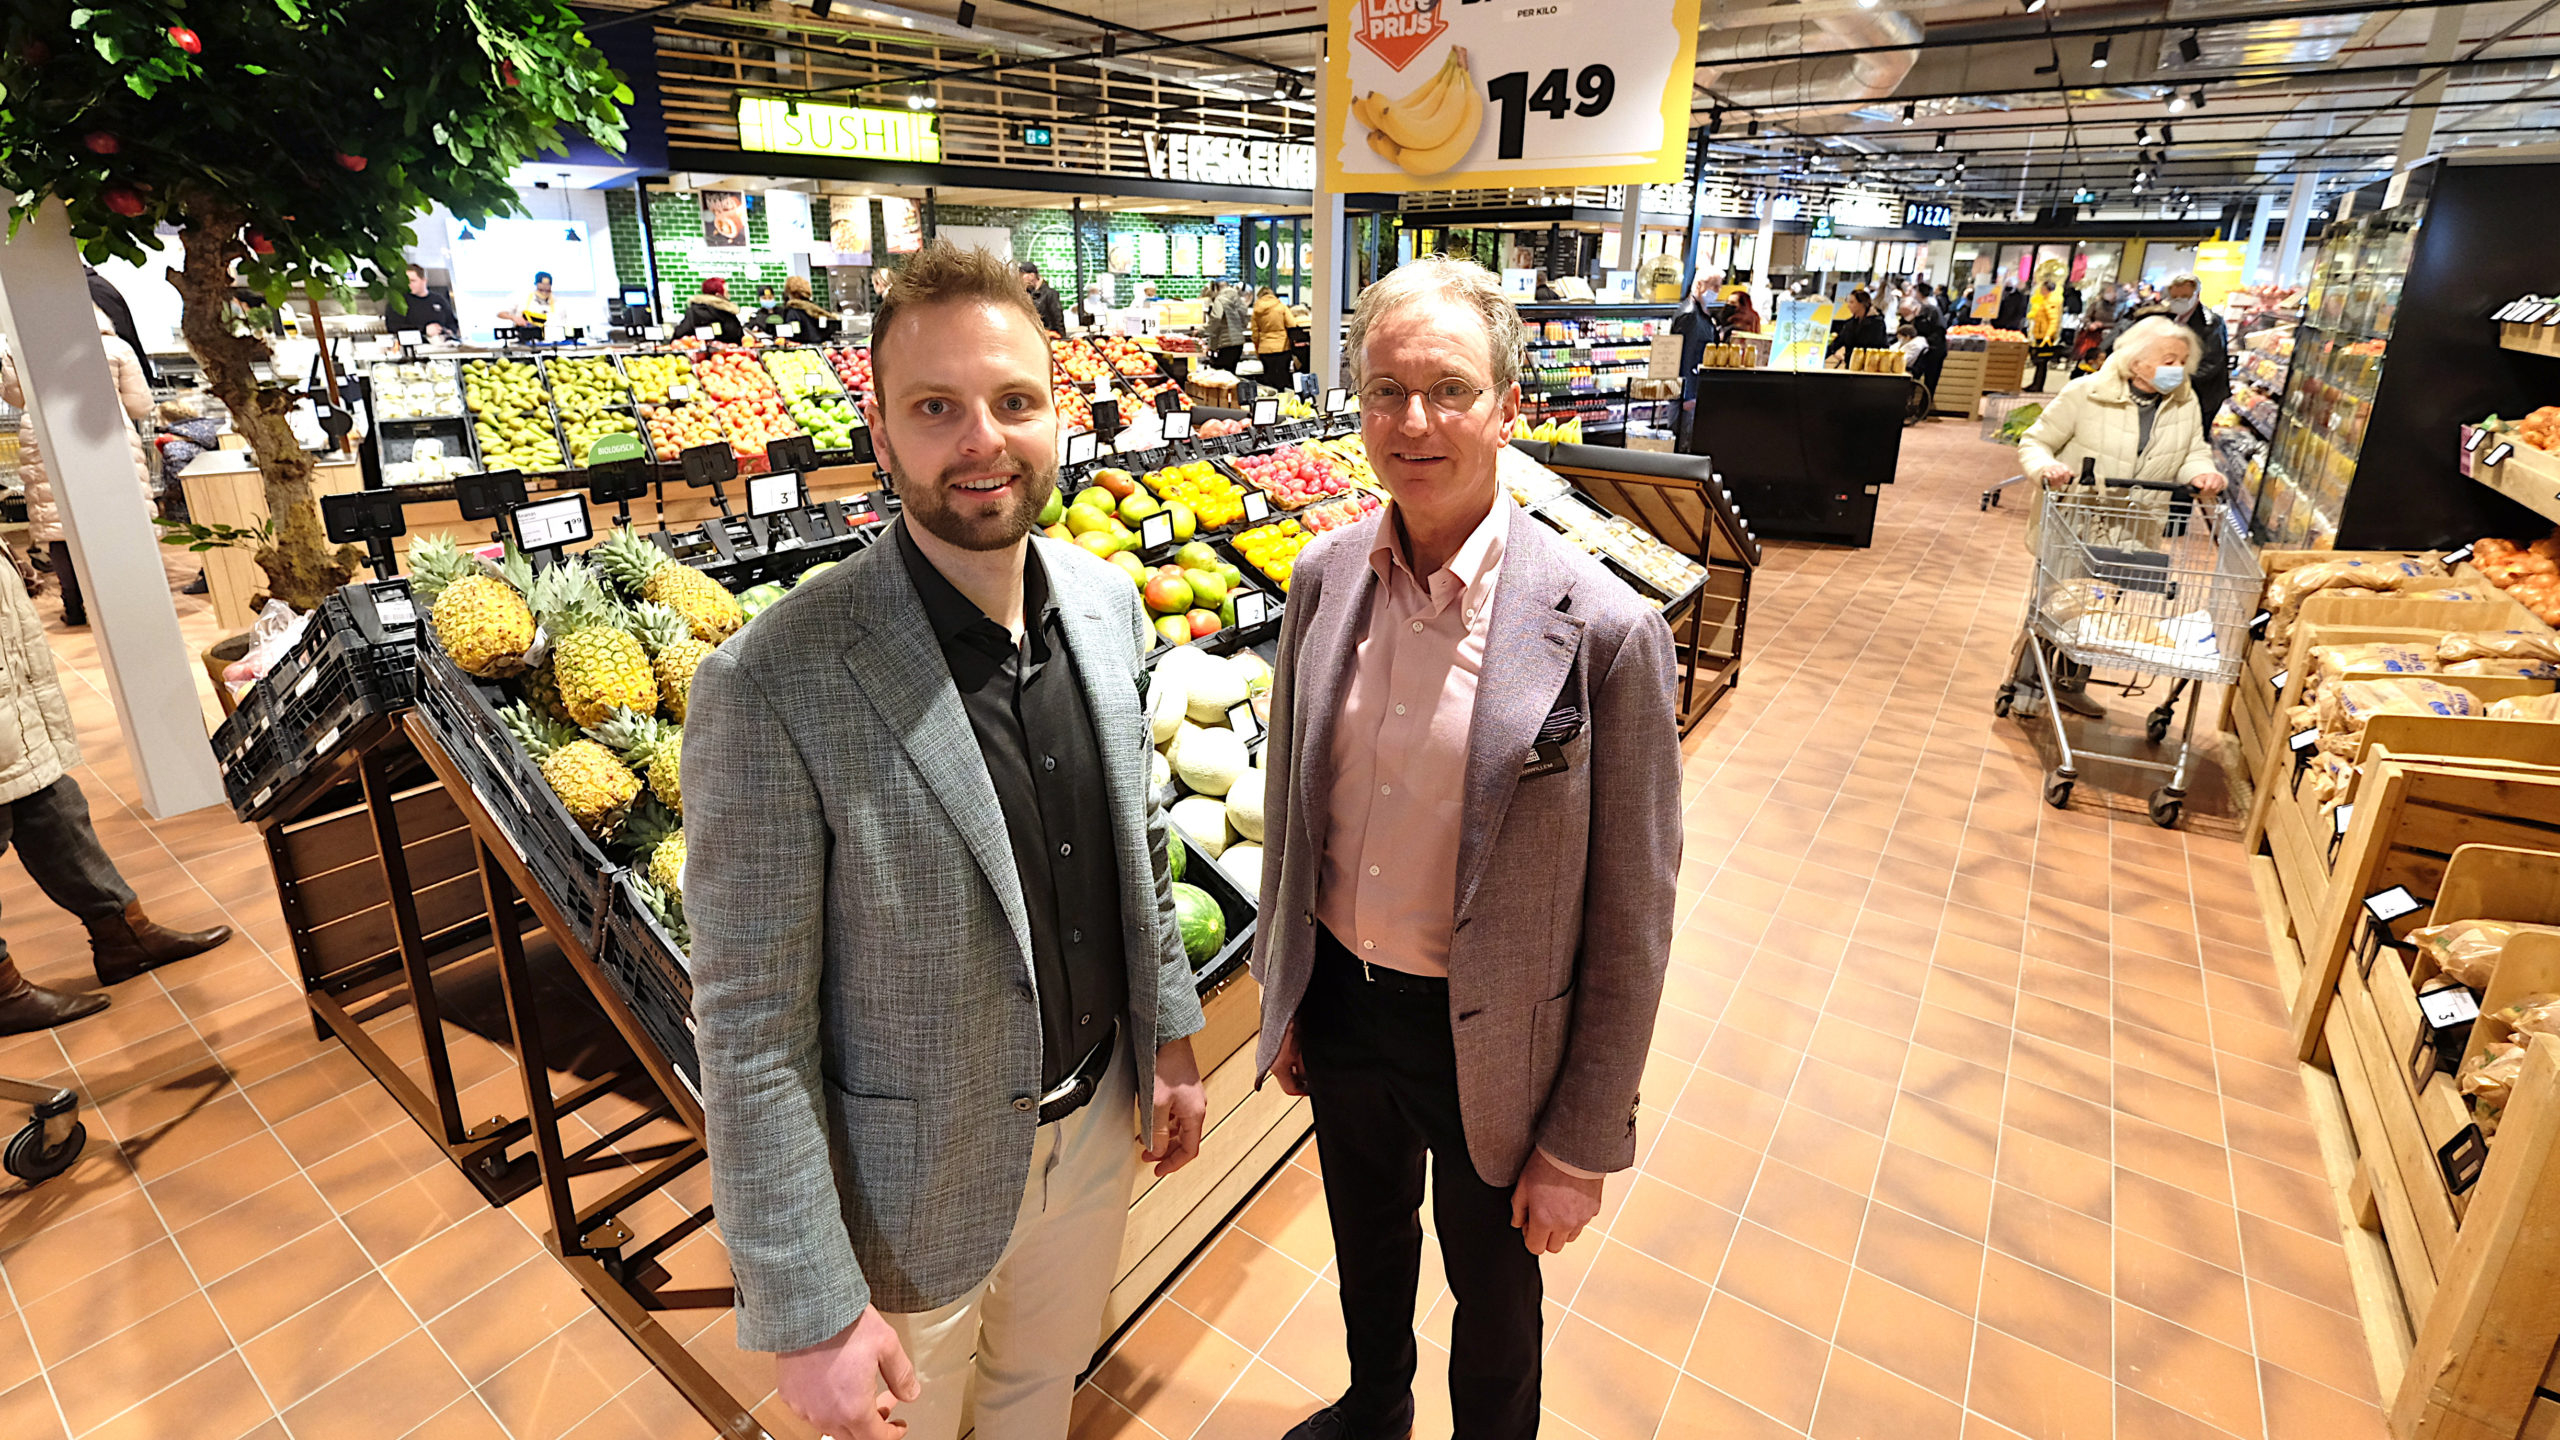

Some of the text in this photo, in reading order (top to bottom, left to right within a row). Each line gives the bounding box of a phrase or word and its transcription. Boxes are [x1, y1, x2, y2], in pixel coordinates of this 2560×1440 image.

[1517, 6, 1557, 18] PER KILO
[1369, 12, 1432, 40] PRIJS
[784, 111, 898, 153] SUSHI
[597, 443, 635, 456] BIOLOGISCH
[564, 517, 582, 534] 199
